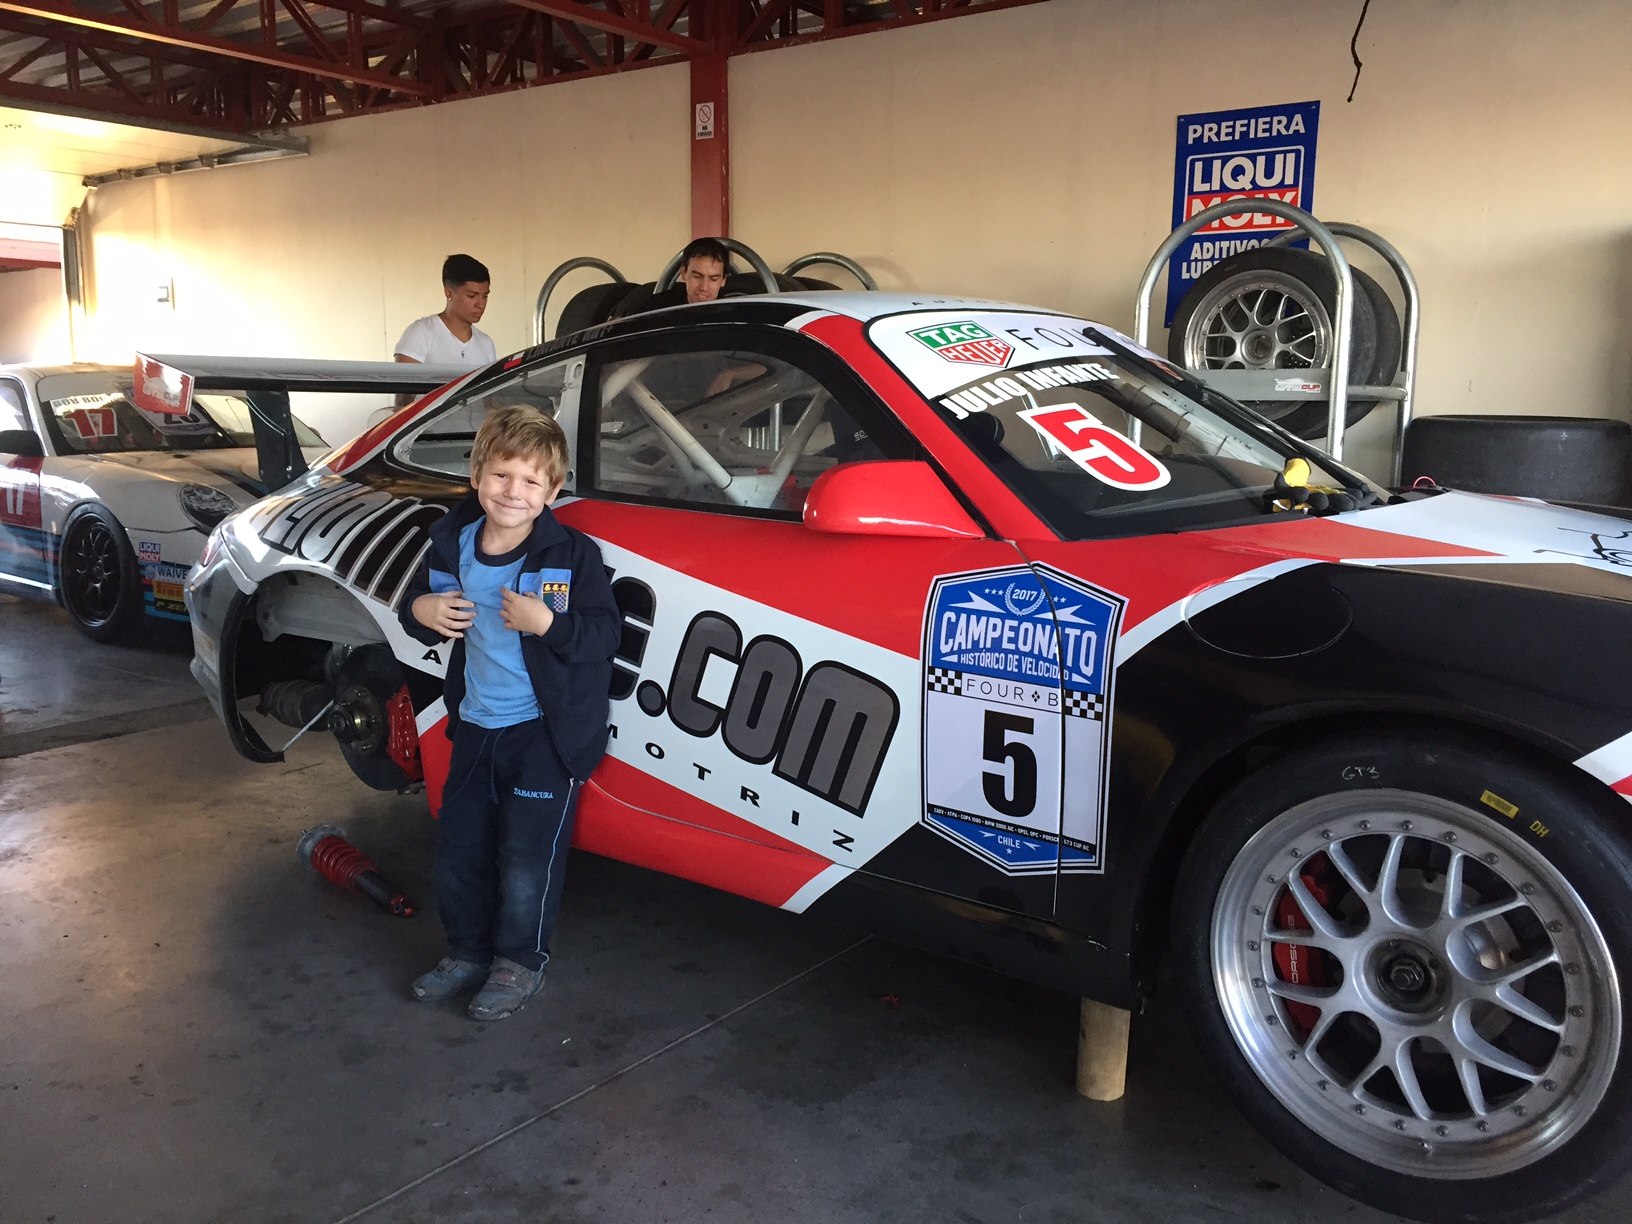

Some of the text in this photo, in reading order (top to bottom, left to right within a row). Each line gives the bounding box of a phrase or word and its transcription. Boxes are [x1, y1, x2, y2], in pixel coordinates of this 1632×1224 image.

[1187, 113, 1306, 145] PREFIERA
[1193, 152, 1296, 192] LIQUI
[1190, 190, 1298, 229] MOLY
[918, 324, 986, 346] TAG
[1005, 326, 1104, 350] FOU
[941, 337, 1008, 366] HEUER
[939, 376, 1030, 420] JULIO
[1014, 362, 1120, 391] INFANTE
[63, 408, 118, 439] 17
[1026, 405, 1166, 488] 5
[140, 542, 160, 552] LIQUI
[140, 551, 160, 562] MOLY
[157, 566, 189, 579] WAIVE
[1012, 588, 1037, 601] 2017
[940, 611, 1098, 677] CAMPEONATO
[960, 650, 1006, 670] HISTÓRICO
[1007, 657, 1017, 671] DE
[965, 678, 1059, 706] FOUR B
[981, 709, 1038, 818] 5
[1341, 766, 1380, 780] GT3
[513, 787, 554, 799] TABANCURA
[960, 814, 972, 822] COPA
[1018, 828, 1029, 836] OPEL
[1042, 833, 1060, 843] PORSC
[1073, 840, 1082, 848] CUP
[997, 835, 1021, 849] CHILE
[1529, 820, 1549, 838] DH
